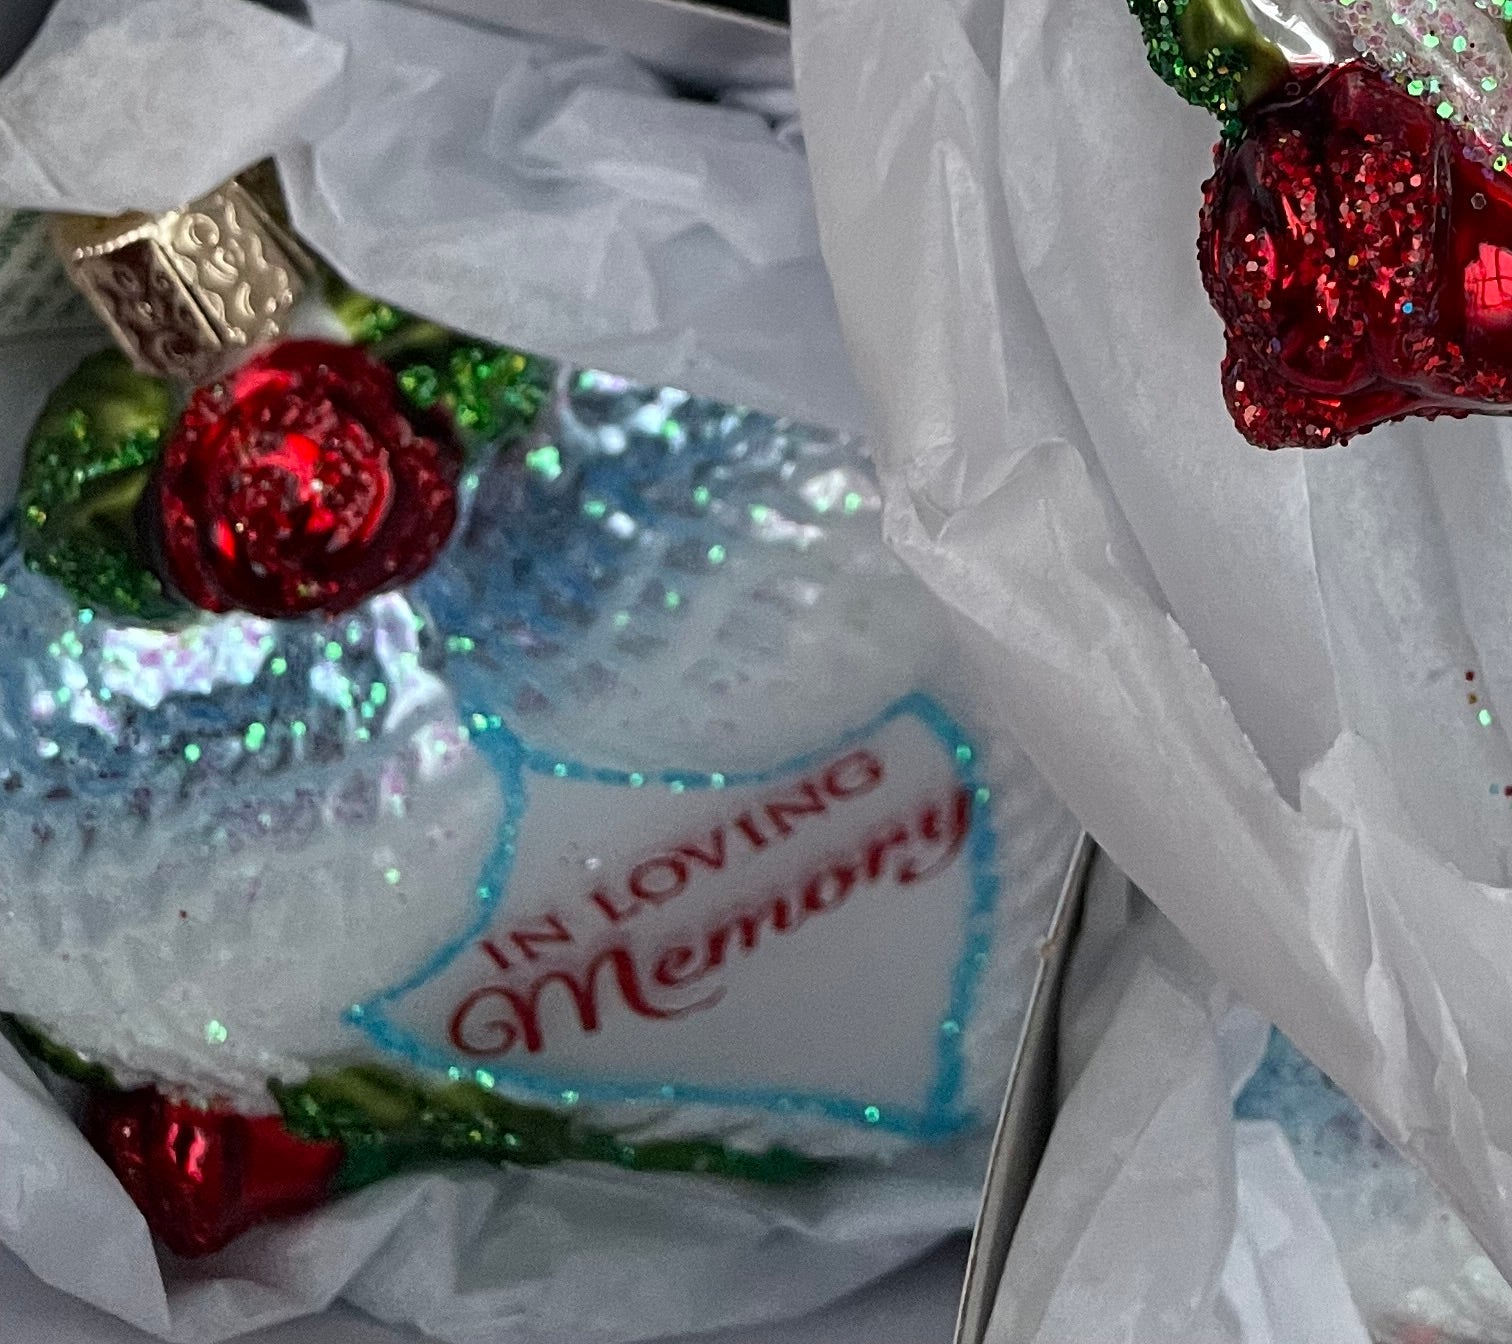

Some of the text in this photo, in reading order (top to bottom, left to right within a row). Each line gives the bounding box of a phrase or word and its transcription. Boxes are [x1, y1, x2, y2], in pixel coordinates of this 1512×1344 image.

[447, 790, 972, 1058] Memory
[479, 749, 883, 970] IN LOVING
